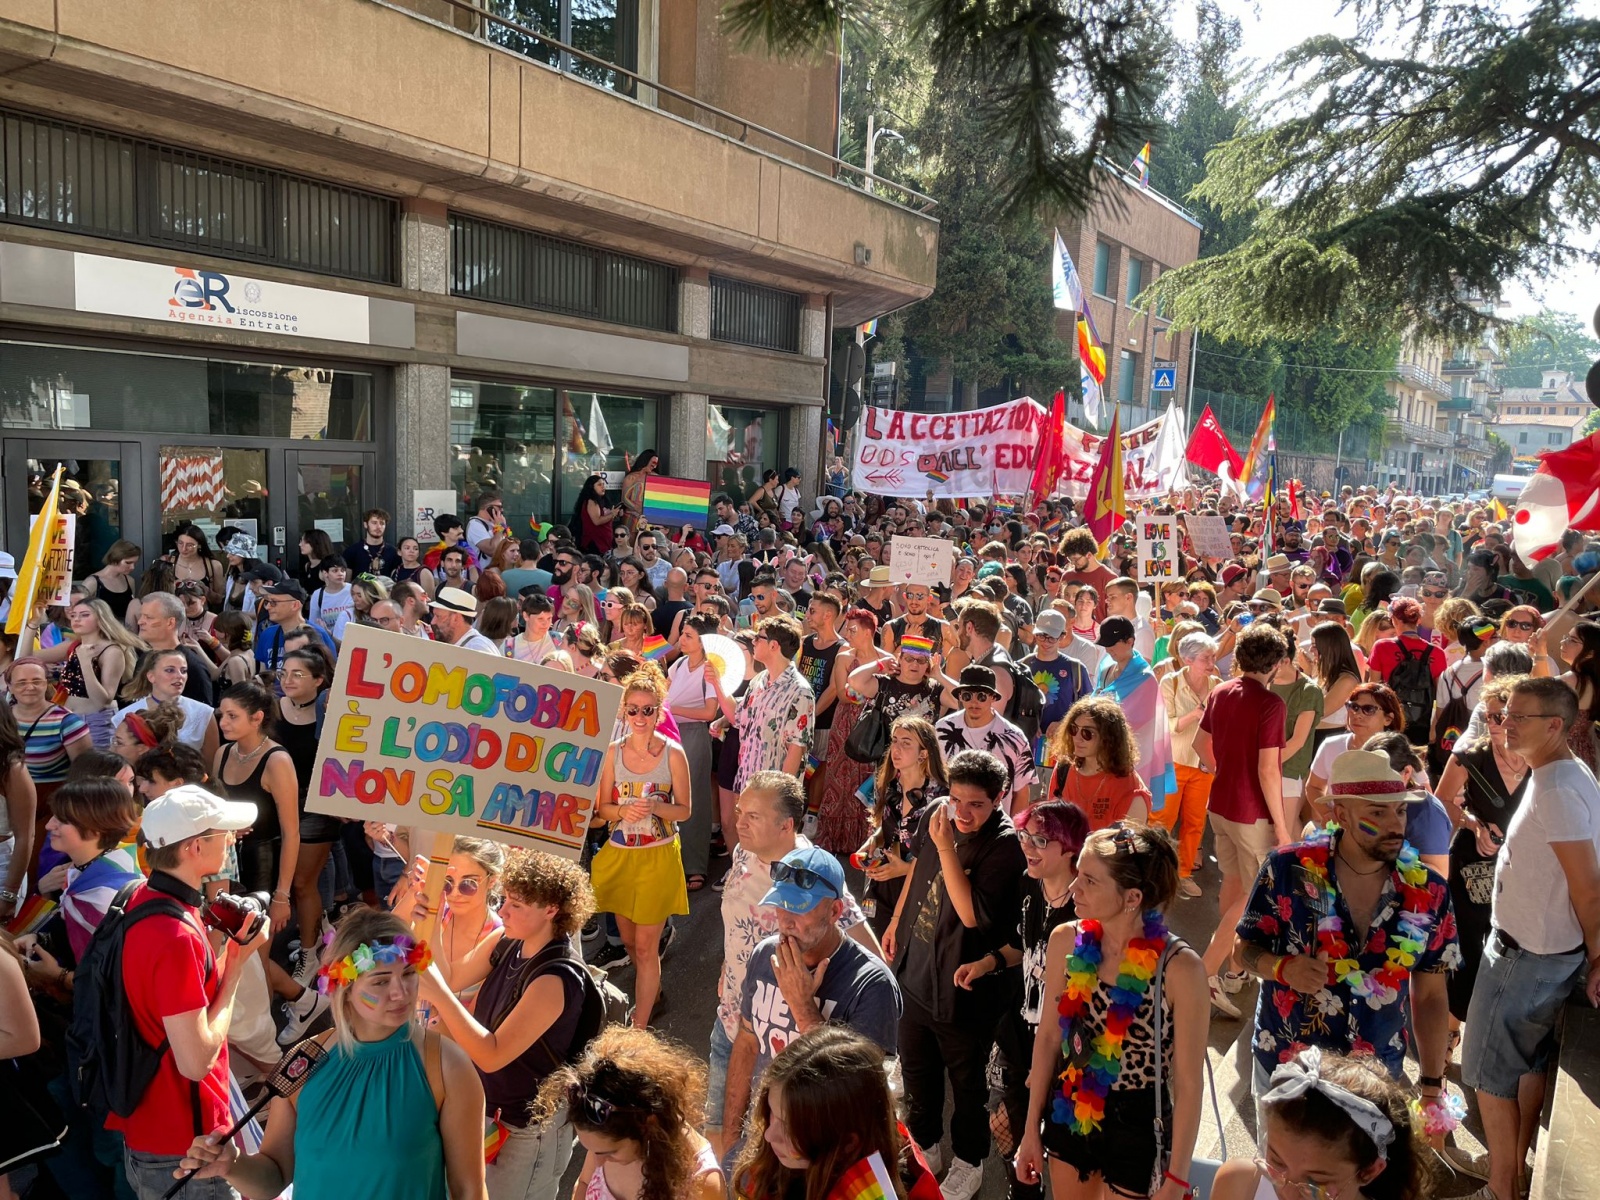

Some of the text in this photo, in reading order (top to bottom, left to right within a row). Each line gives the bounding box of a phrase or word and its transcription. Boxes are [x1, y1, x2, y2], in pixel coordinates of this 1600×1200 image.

[168, 309, 298, 332] Agenzia Entrate
[1144, 523, 1170, 540] LOVE
[1151, 541, 1167, 561] IS
[1144, 559, 1172, 577] LOVE
[346, 647, 600, 737] L'OMOFOBIA
[335, 700, 371, 753] È
[504, 732, 545, 773] DI
[545, 742, 603, 786] CHI
[319, 758, 592, 837] NON SA AMARE
